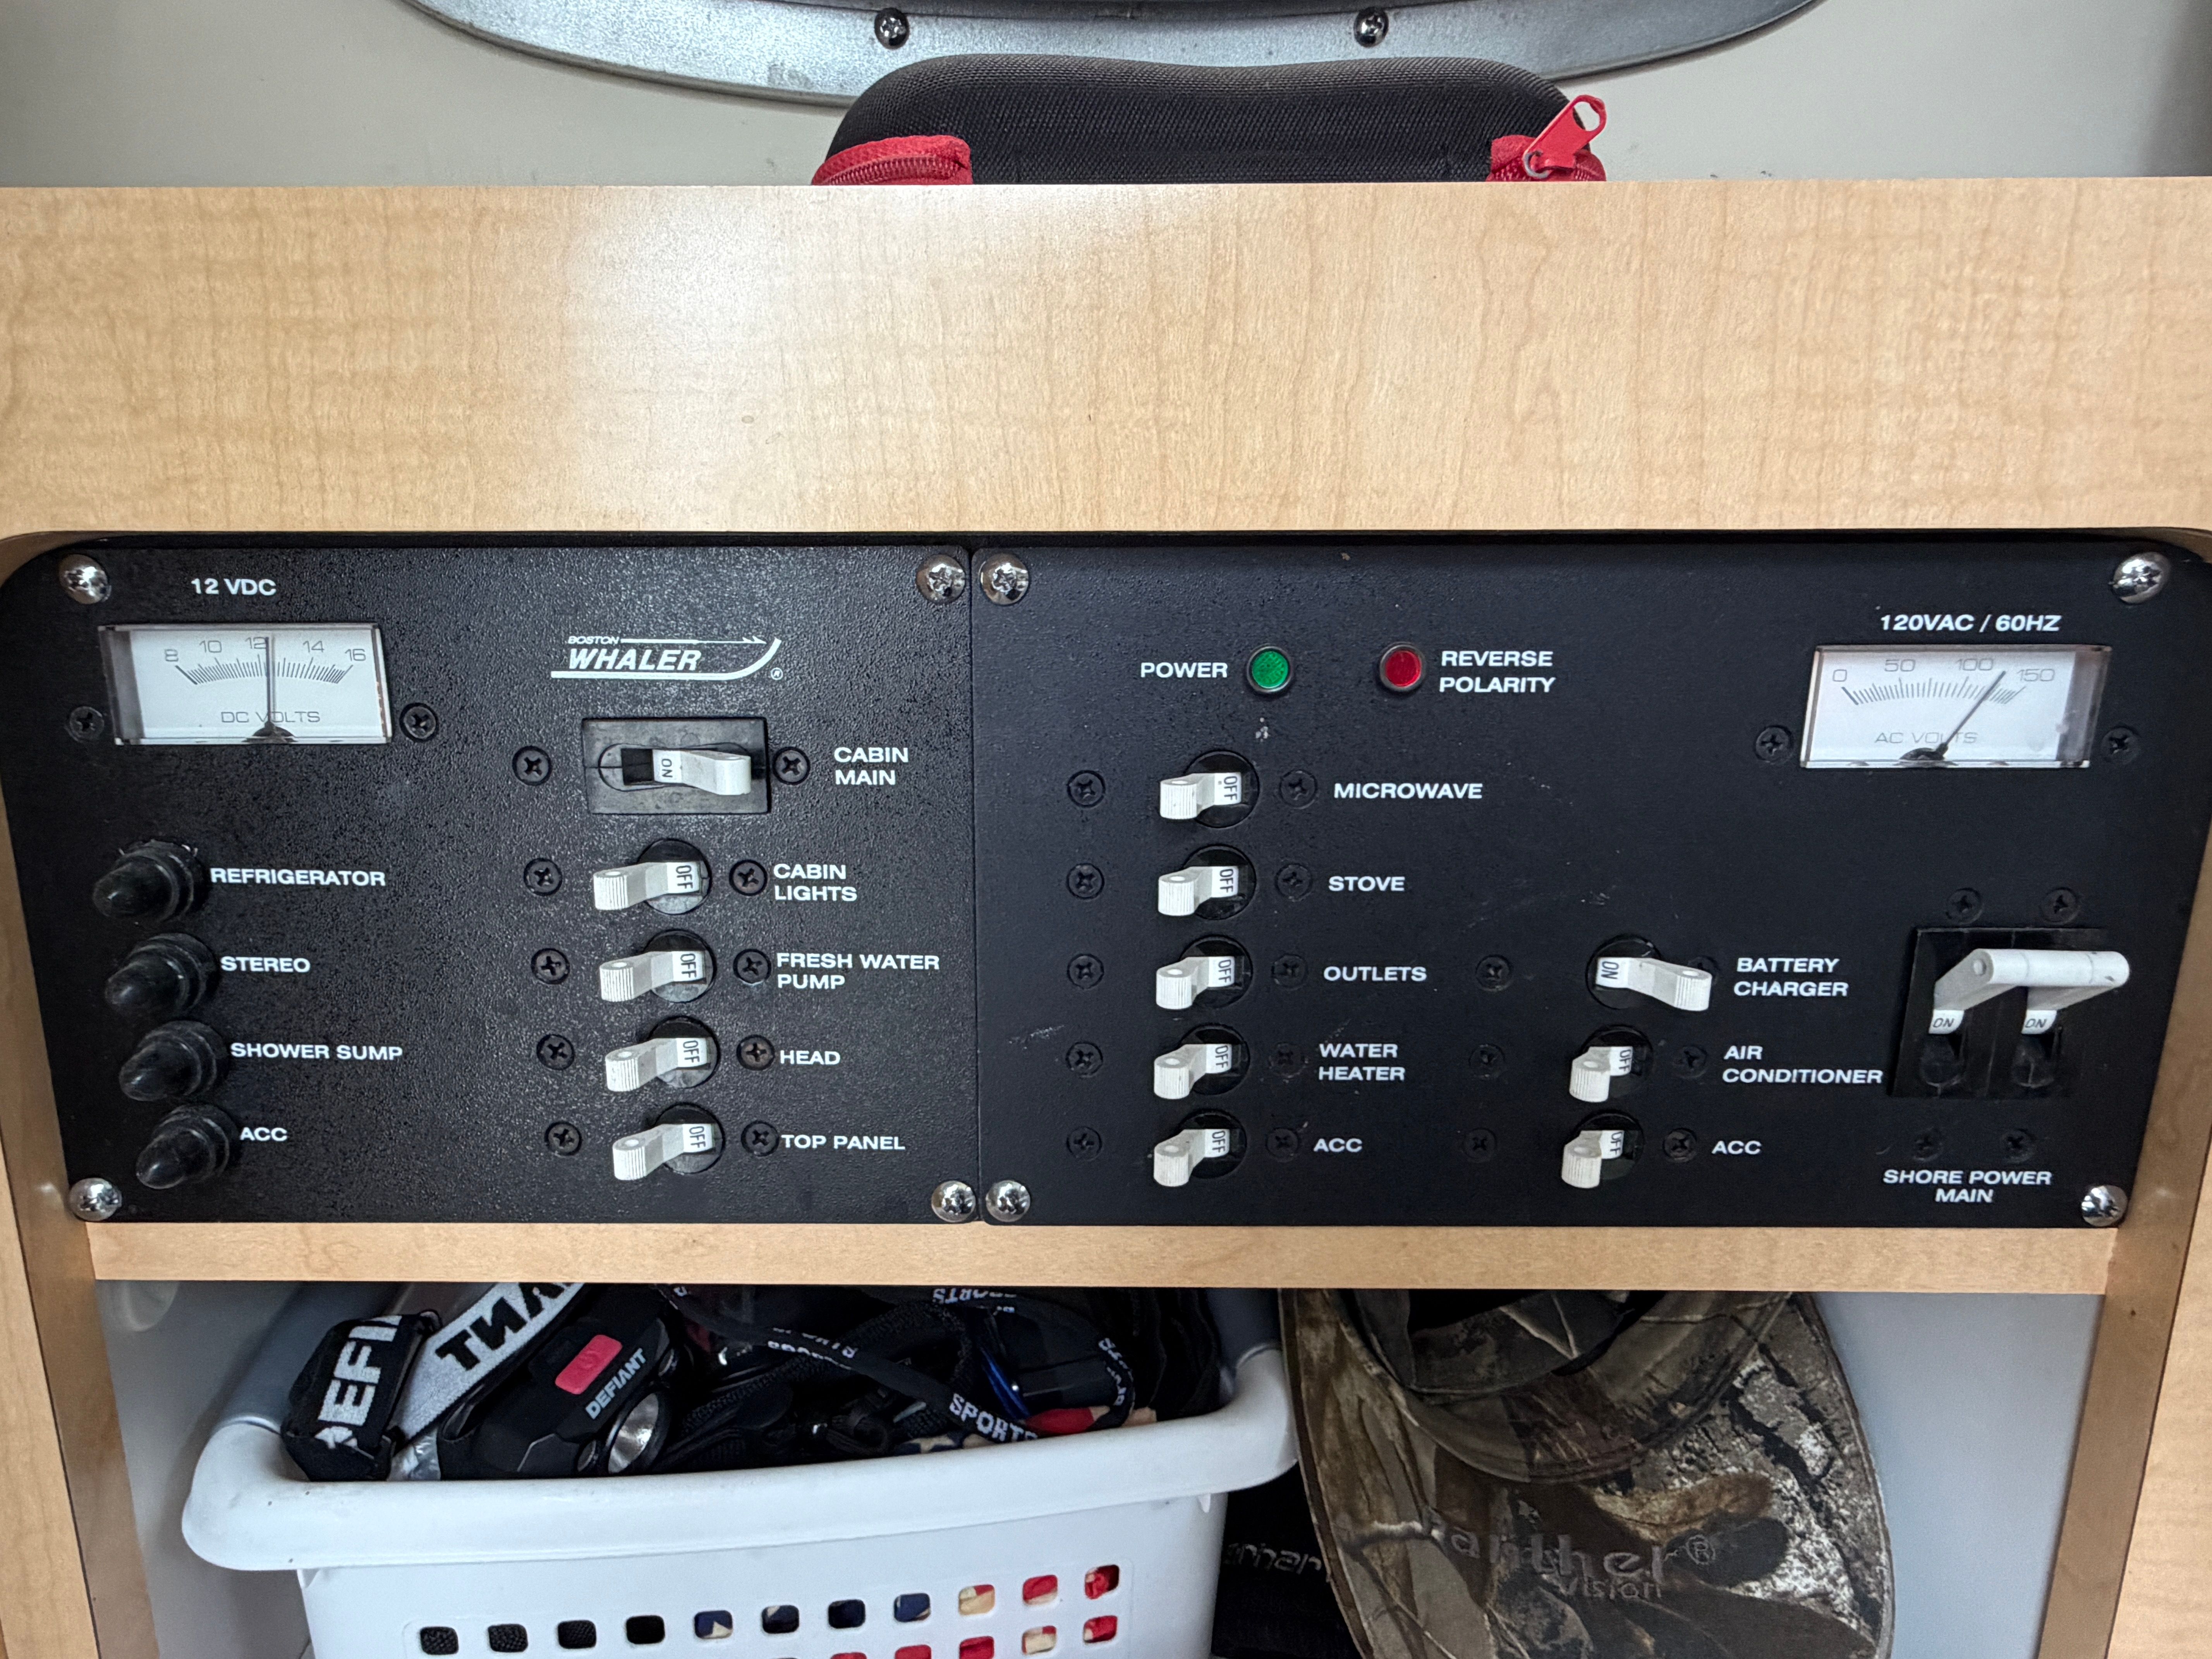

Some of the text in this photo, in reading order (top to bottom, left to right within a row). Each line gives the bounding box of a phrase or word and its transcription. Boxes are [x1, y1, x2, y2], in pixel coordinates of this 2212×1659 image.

[191, 578, 276, 596] 12 VDC
[1881, 614, 1975, 631] 120VAC
[1995, 615, 2061, 632] 60HZ
[567, 635, 620, 645] BOSTON
[164, 637, 366, 662] 8 10 12 14 16
[569, 648, 702, 671] WHALER
[1441, 650, 1553, 667] REVERSE
[1140, 662, 1228, 678] POWER
[1832, 658, 2056, 682] 0 50 100 150
[1439, 676, 1556, 693] POLARITY
[220, 711, 321, 723] DC VOLTS
[1874, 732, 1978, 744] AC VOLTS
[834, 747, 908, 763] CABIN
[661, 758, 673, 778] ON
[835, 769, 896, 785] MAIN
[1223, 775, 1238, 801] OFF
[1334, 783, 1483, 799] MICROWAVE
[210, 868, 386, 886] REFRIGERATOR
[675, 864, 693, 890] OFF
[773, 863, 846, 879] CABIN
[1219, 868, 1234, 892] OFF
[1328, 876, 1405, 891] STOVE
[774, 885, 857, 902] LIGHTS
[221, 956, 311, 973] STEREO
[680, 953, 697, 979] OFF
[776, 953, 939, 970] FRESH WATER
[1601, 960, 1619, 979] ON
[1737, 957, 1839, 972] BATTERY
[1218, 959, 1232, 984] OFF
[1324, 966, 1427, 982] OUTLETS
[777, 974, 845, 989] PUMP
[1734, 981, 1849, 997] CHARGER
[1933, 1018, 1954, 1028] ON
[2025, 1018, 2047, 1028] ON
[231, 1042, 403, 1060] SHOWER SUMP
[683, 1040, 700, 1063] OFF
[780, 1050, 841, 1065] HEAD
[1214, 1045, 1230, 1070] OFF
[1319, 1043, 1398, 1058] WATER
[1724, 1045, 1763, 1060] AIR
[1618, 1049, 1632, 1072] OFF
[1319, 1066, 1405, 1081] HEATER
[1722, 1068, 1883, 1084] CONDITIONER
[240, 1127, 288, 1142] ACC
[689, 1125, 706, 1149] OFF
[781, 1134, 905, 1150] TOP PANEL
[1212, 1130, 1226, 1155] OFF
[1314, 1138, 1362, 1152] ACC
[1712, 1140, 1761, 1155] ACC
[1883, 1169, 2052, 1185] SHORE POWER
[1935, 1188, 1994, 1203] MAIN
[586, 1348, 646, 1420] DEFIANT
